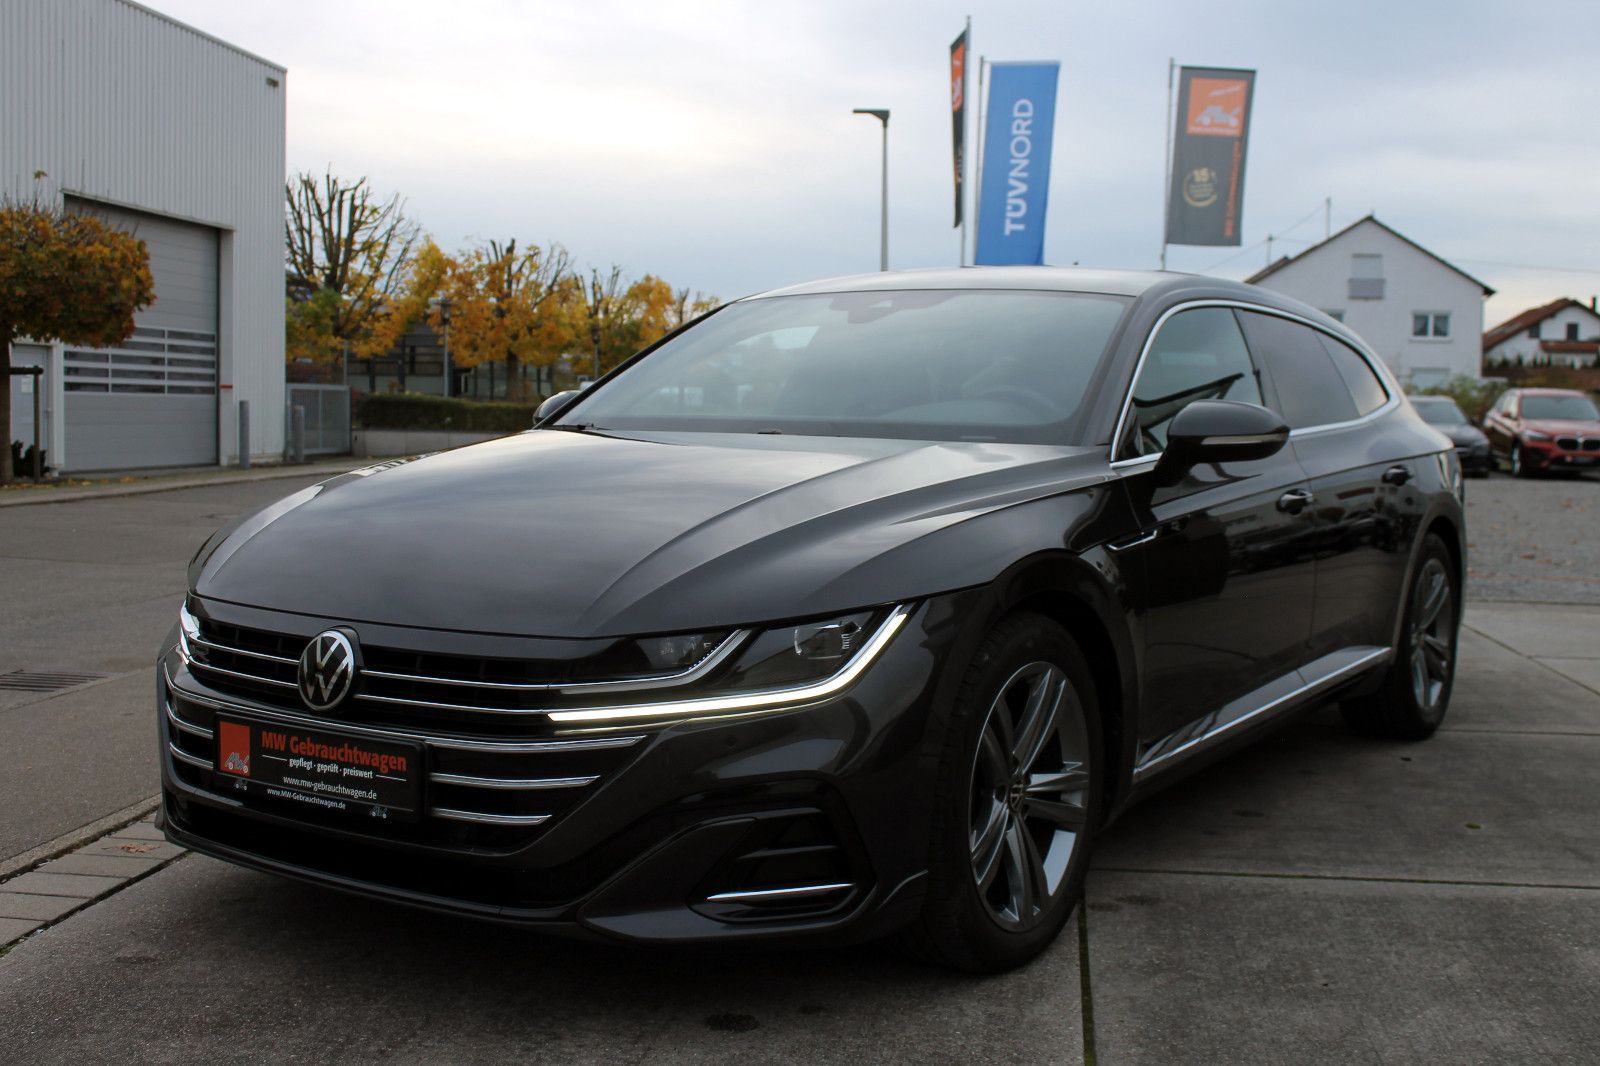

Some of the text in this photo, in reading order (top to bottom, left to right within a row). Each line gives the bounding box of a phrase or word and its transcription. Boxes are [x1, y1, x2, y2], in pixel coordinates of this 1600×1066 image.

[262, 731, 407, 774] MW Gebrauchtwagen
[289, 757, 373, 779] gepflegt geprüft preiswert
[283, 775, 377, 800] www.mw-gebrauchtwagen.de
